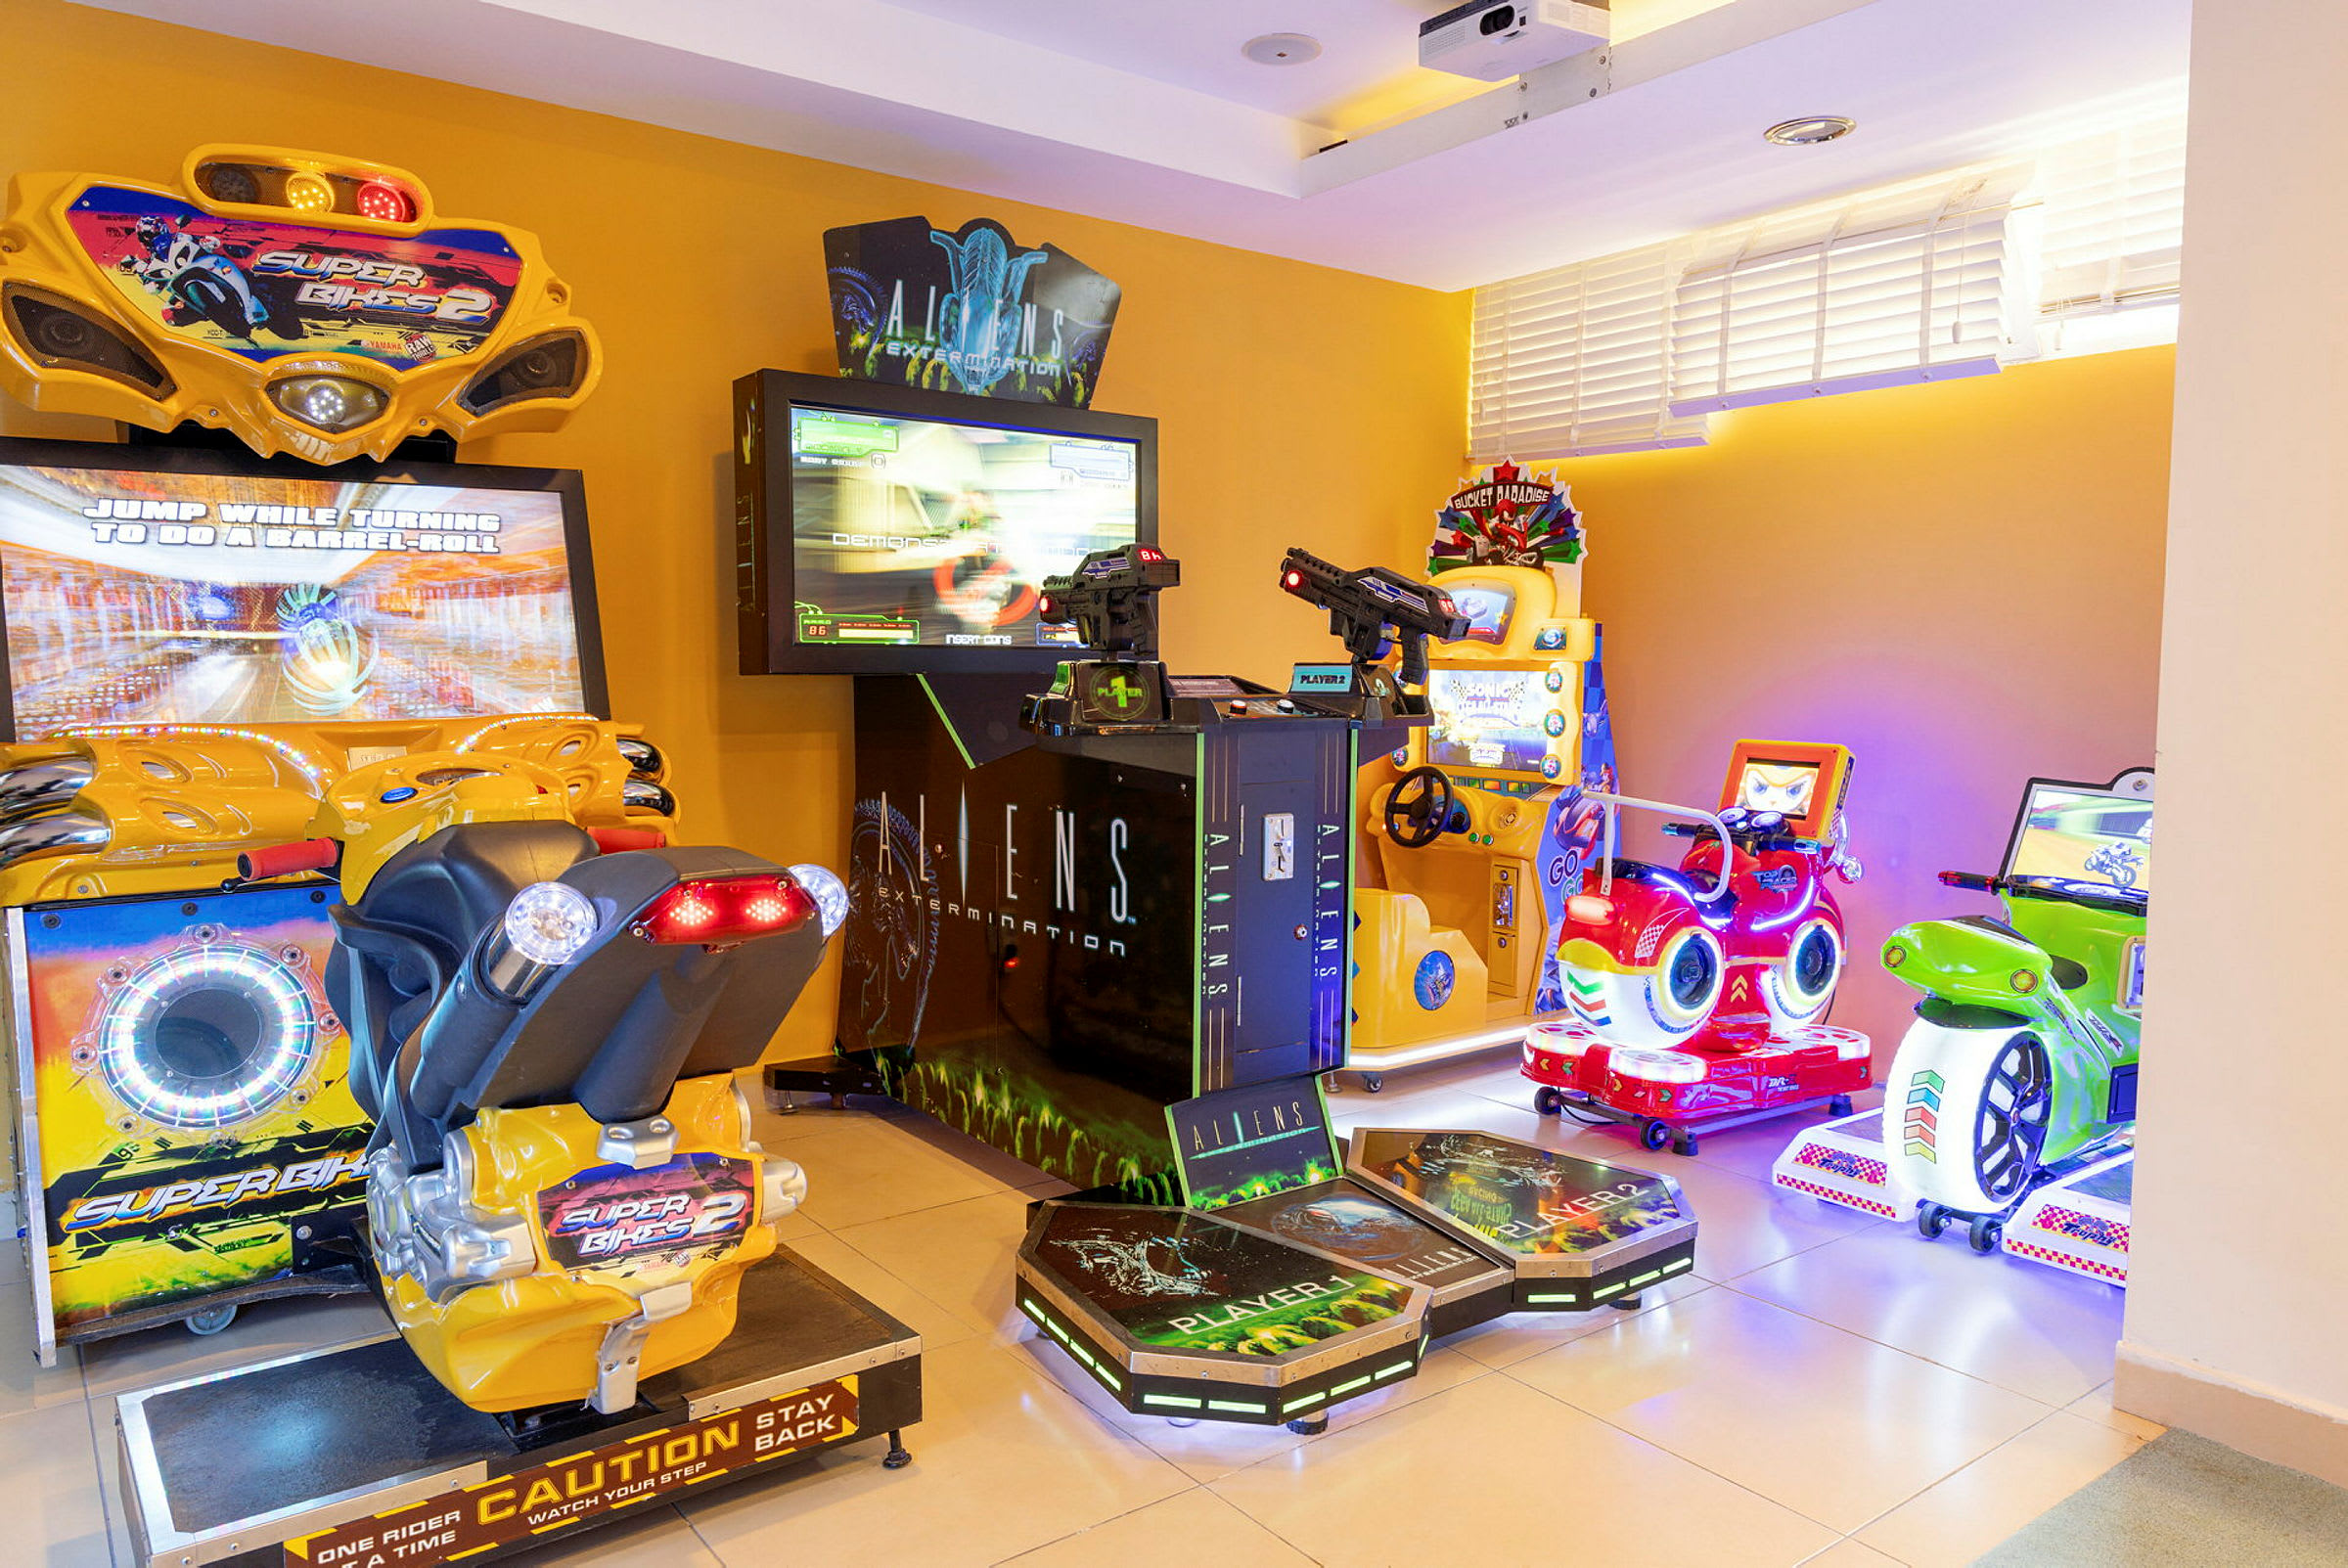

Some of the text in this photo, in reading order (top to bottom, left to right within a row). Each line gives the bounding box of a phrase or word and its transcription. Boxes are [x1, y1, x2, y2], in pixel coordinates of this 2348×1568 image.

[252, 251, 426, 287] SUPER
[295, 282, 493, 323] BIKES 2
[887, 279, 1063, 359] ALIENS
[406, 335, 431, 353] RAW
[886, 340, 1061, 378] EXTERMINATION
[83, 498, 501, 532] JUMP WHILE TURNING
[1454, 485, 1550, 509] BUCKET PARADISE
[92, 522, 501, 554] TO DO A BARREL-ROLL
[1440, 600, 1455, 613] 99
[945, 634, 980, 645] INSERT
[1300, 675, 1345, 684] PLAYER 2
[879, 780, 1128, 922] ALIENS
[1549, 849, 1578, 886] GO
[1207, 833, 1232, 996] ALIENS
[1319, 825, 1341, 977] ALIENS
[879, 886, 1125, 958] EXTERMINATION
[1194, 1101, 1303, 1151] ALIENS
[1819, 1157, 1862, 1178] Trophy
[65, 1154, 370, 1231] SUPER BIK
[1496, 1183, 1649, 1238] PLAYER 2
[556, 1194, 690, 1232] SUPER
[578, 1192, 747, 1256] BIKES 2
[2062, 1222, 2117, 1246] Trophy
[1168, 1275, 1356, 1335] PLAYER 1
[756, 1393, 835, 1430] STAY
[754, 1413, 835, 1452] BACK
[476, 1420, 740, 1526] CAUTION
[527, 1461, 707, 1525] WATCH YOUR STEP
[317, 1510, 461, 1564] ONE RIDER
[392, 1530, 457, 1558] TIME
